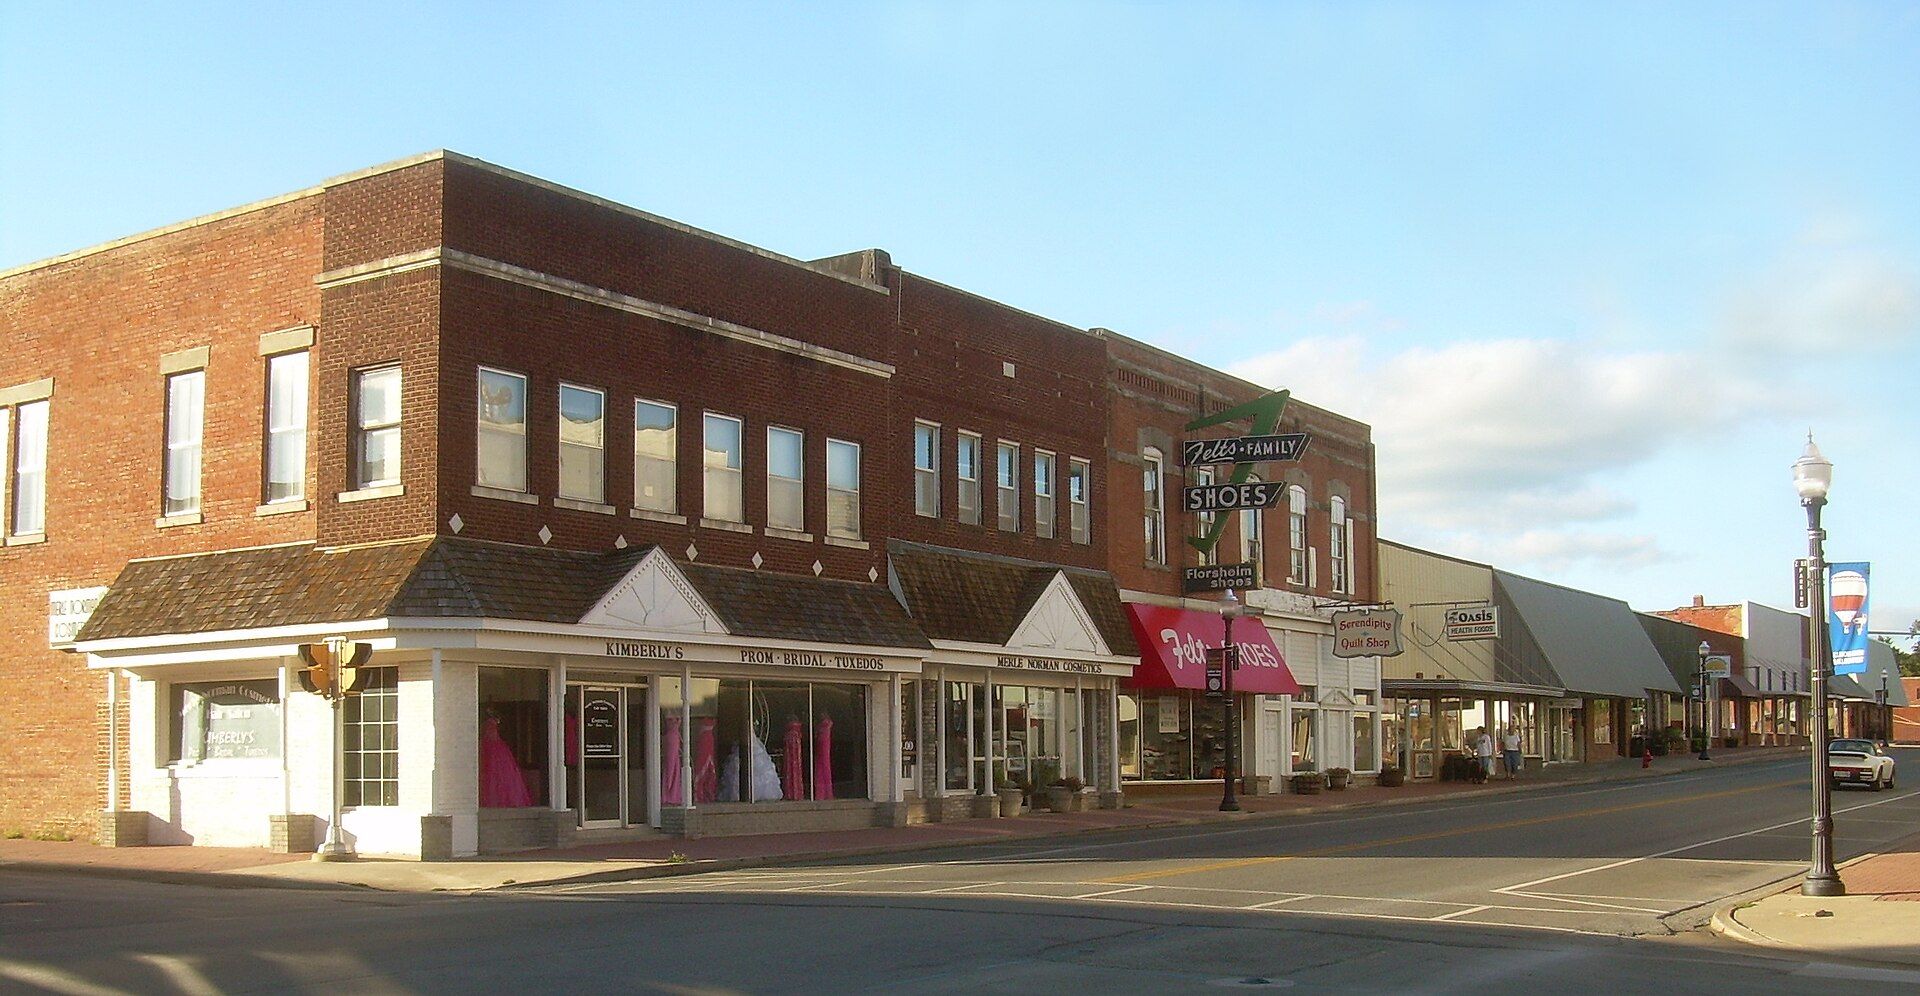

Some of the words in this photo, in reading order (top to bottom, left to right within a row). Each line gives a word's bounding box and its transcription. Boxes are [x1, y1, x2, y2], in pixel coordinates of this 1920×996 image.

[1186, 440, 1236, 464] Felts
[1247, 440, 1296, 456] FAMILY
[1190, 486, 1267, 509] SHOES
[1186, 566, 1252, 579] Florsheim
[1210, 577, 1252, 588] shoes
[1340, 618, 1391, 631] Serendipity
[1341, 638, 1363, 650] Quilt
[1366, 637, 1390, 649] Shop
[741, 650, 774, 664] PROM
[783, 653, 826, 666] BRIDAL
[835, 656, 884, 669] TUXEDOS
[997, 657, 1023, 668] MERLE
[1027, 659, 1059, 671] NORMAN
[1063, 661, 1102, 673] COSMETICS
